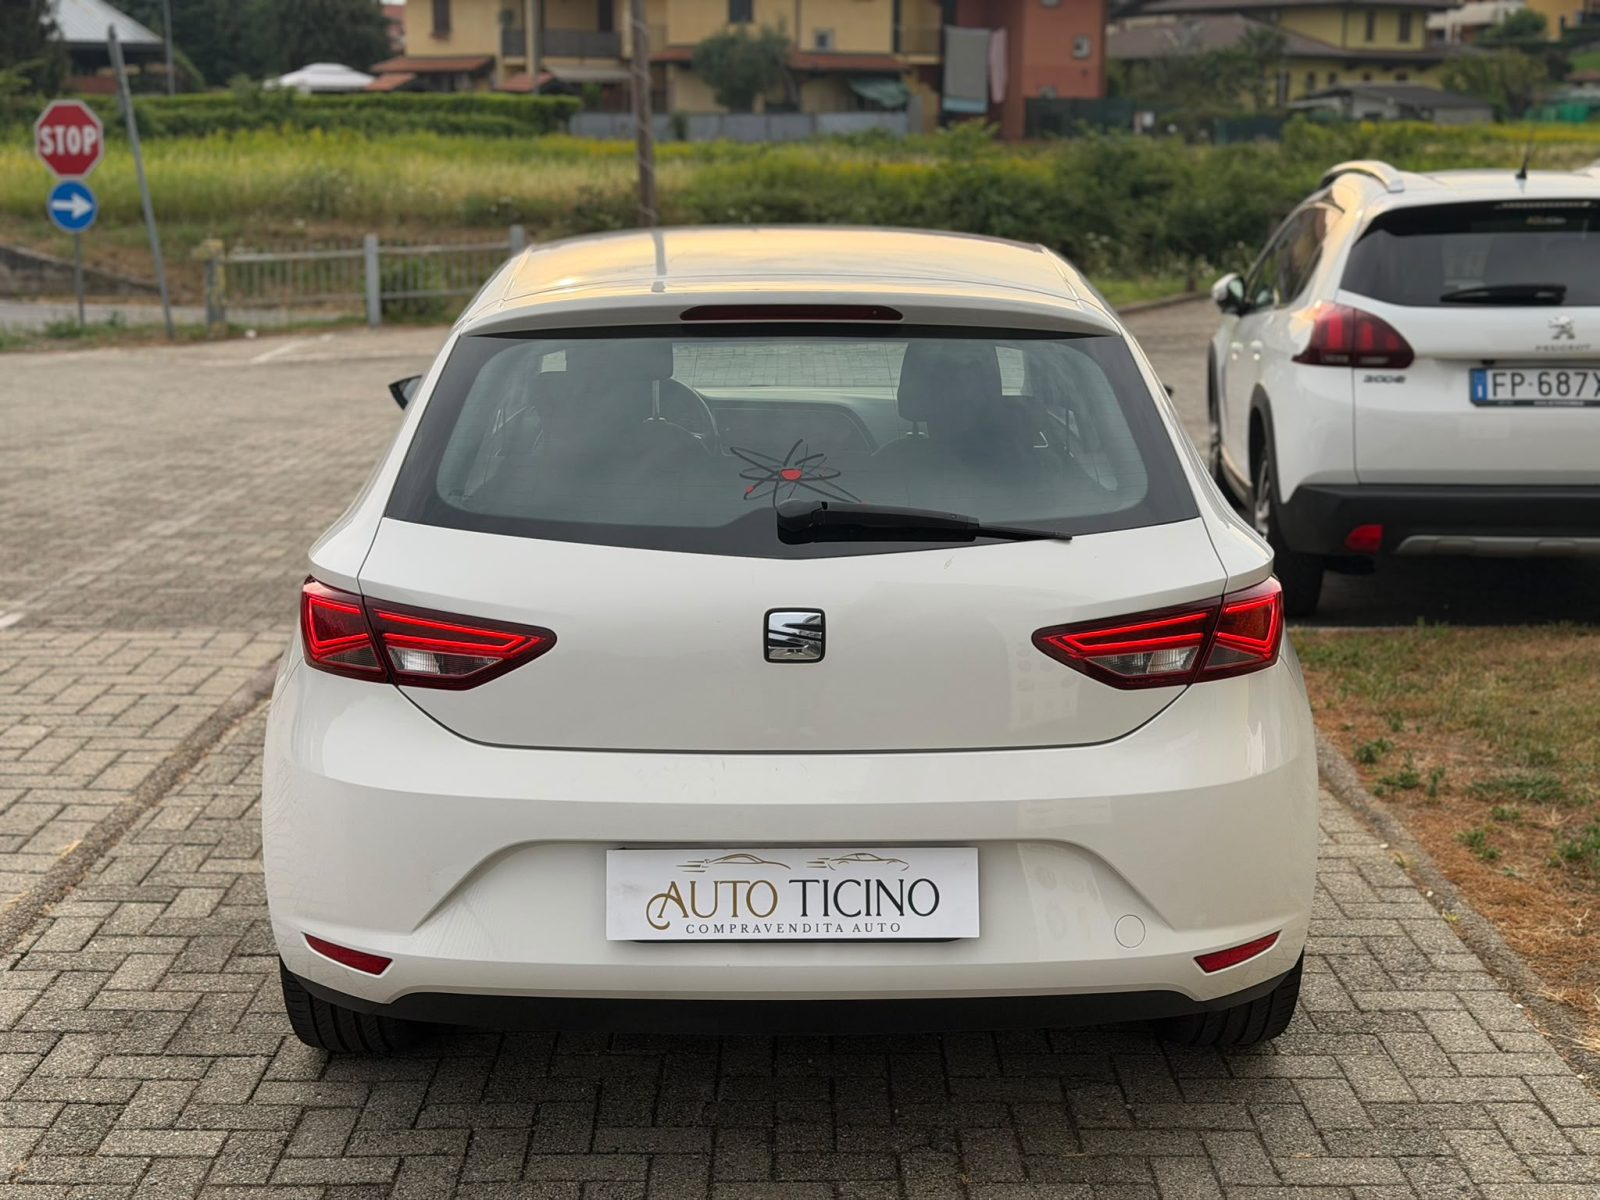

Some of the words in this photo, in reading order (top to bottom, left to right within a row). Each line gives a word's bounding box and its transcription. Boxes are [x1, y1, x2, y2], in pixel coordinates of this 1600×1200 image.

[40, 125, 97, 156] STOP
[646, 879, 778, 930] AUTO
[789, 878, 940, 917] TICINO
[685, 923, 844, 934] COMPRAVENDITA
[852, 922, 902, 933] AUTO
